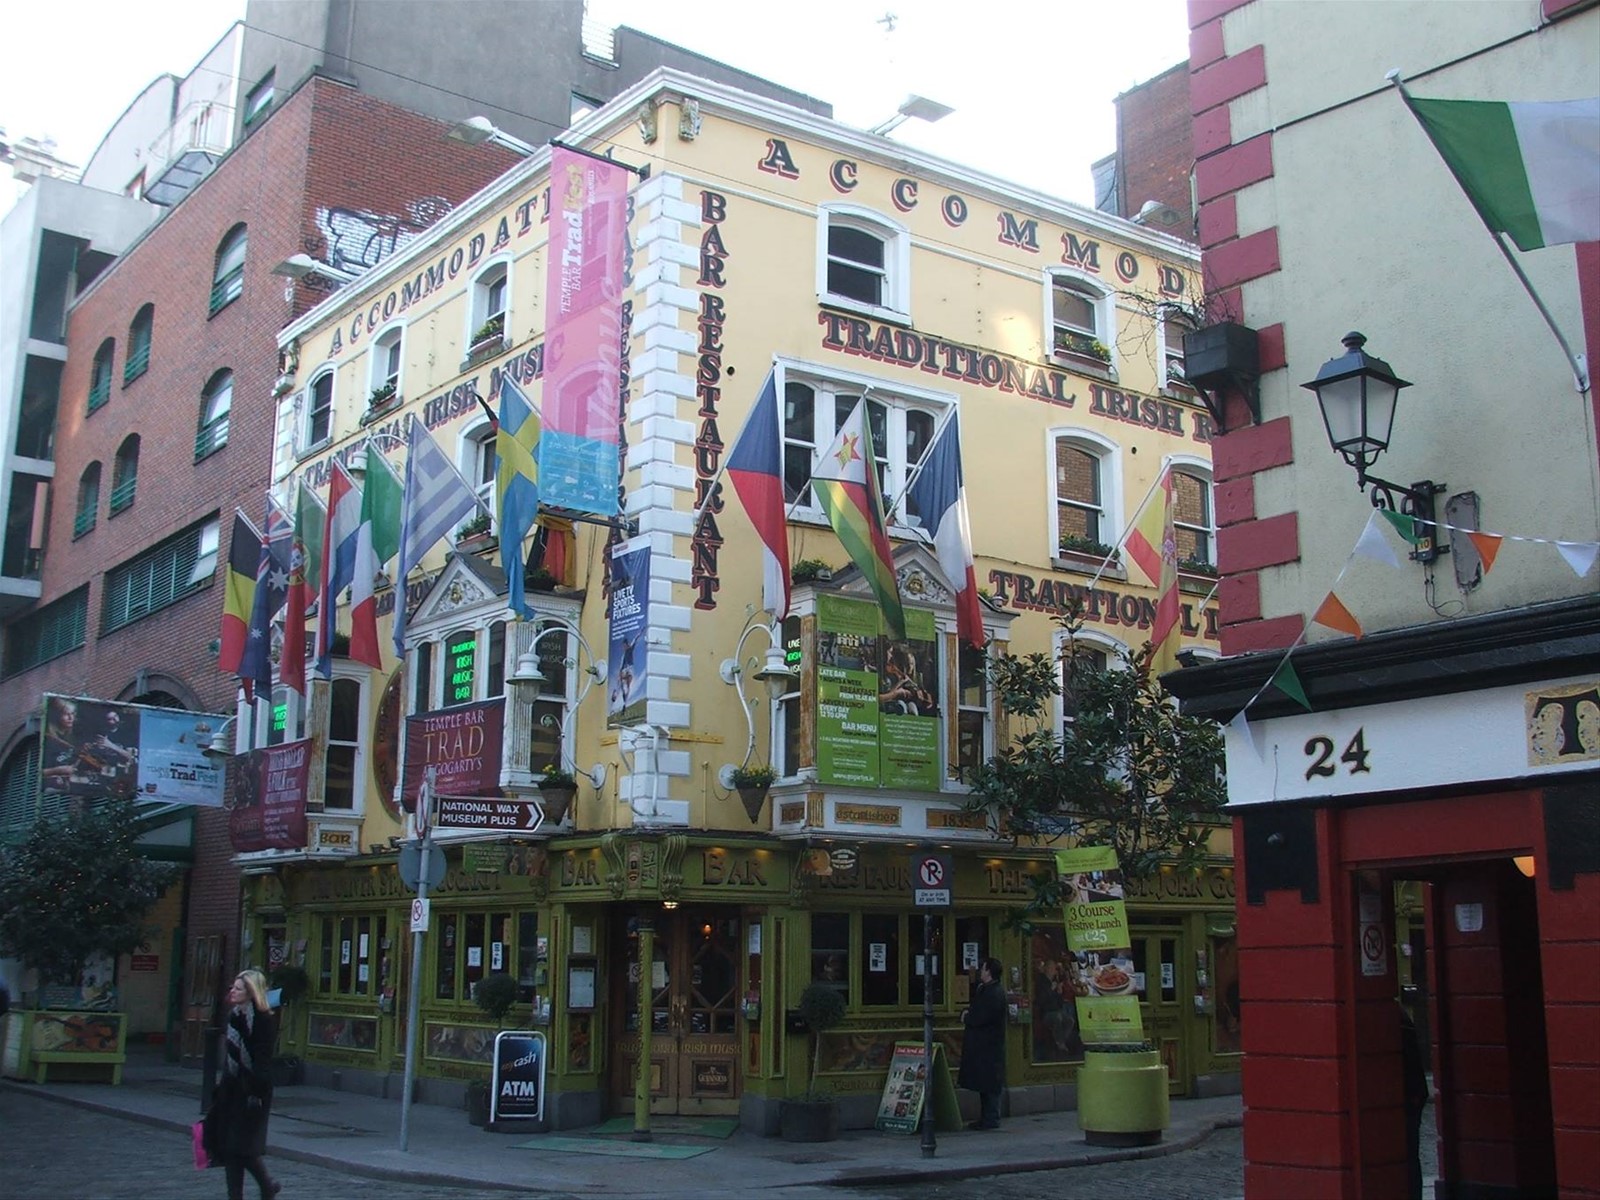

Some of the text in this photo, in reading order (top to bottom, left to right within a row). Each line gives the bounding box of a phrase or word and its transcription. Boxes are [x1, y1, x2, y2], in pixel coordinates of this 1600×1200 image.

[560, 267, 572, 314] TEMPLE
[571, 266, 583, 292] BAR
[818, 309, 1076, 408] TRADITIONAL
[1088, 382, 1184, 438] IRISH
[424, 375, 480, 431] IRISH
[690, 190, 729, 611] BAR RESTAURANT
[612, 603, 642, 620] FIXTURES
[613, 595, 635, 610] SPORTS
[989, 568, 1200, 639] TRADITIONL
[424, 709, 485, 732] TEMPLE BAR
[841, 721, 877, 732] BAR MENU
[423, 725, 485, 763] TRAD
[1304, 727, 1372, 782] 24
[441, 813, 518, 826] MUSEUM PLUS
[442, 800, 521, 814] NATIONAL WAX
[561, 851, 600, 887] BAR
[701, 850, 768, 887] BAR
[1069, 904, 1115, 921] 3 Course
[1096, 917, 1122, 929] Lunch
[501, 1080, 535, 1097] ATM
